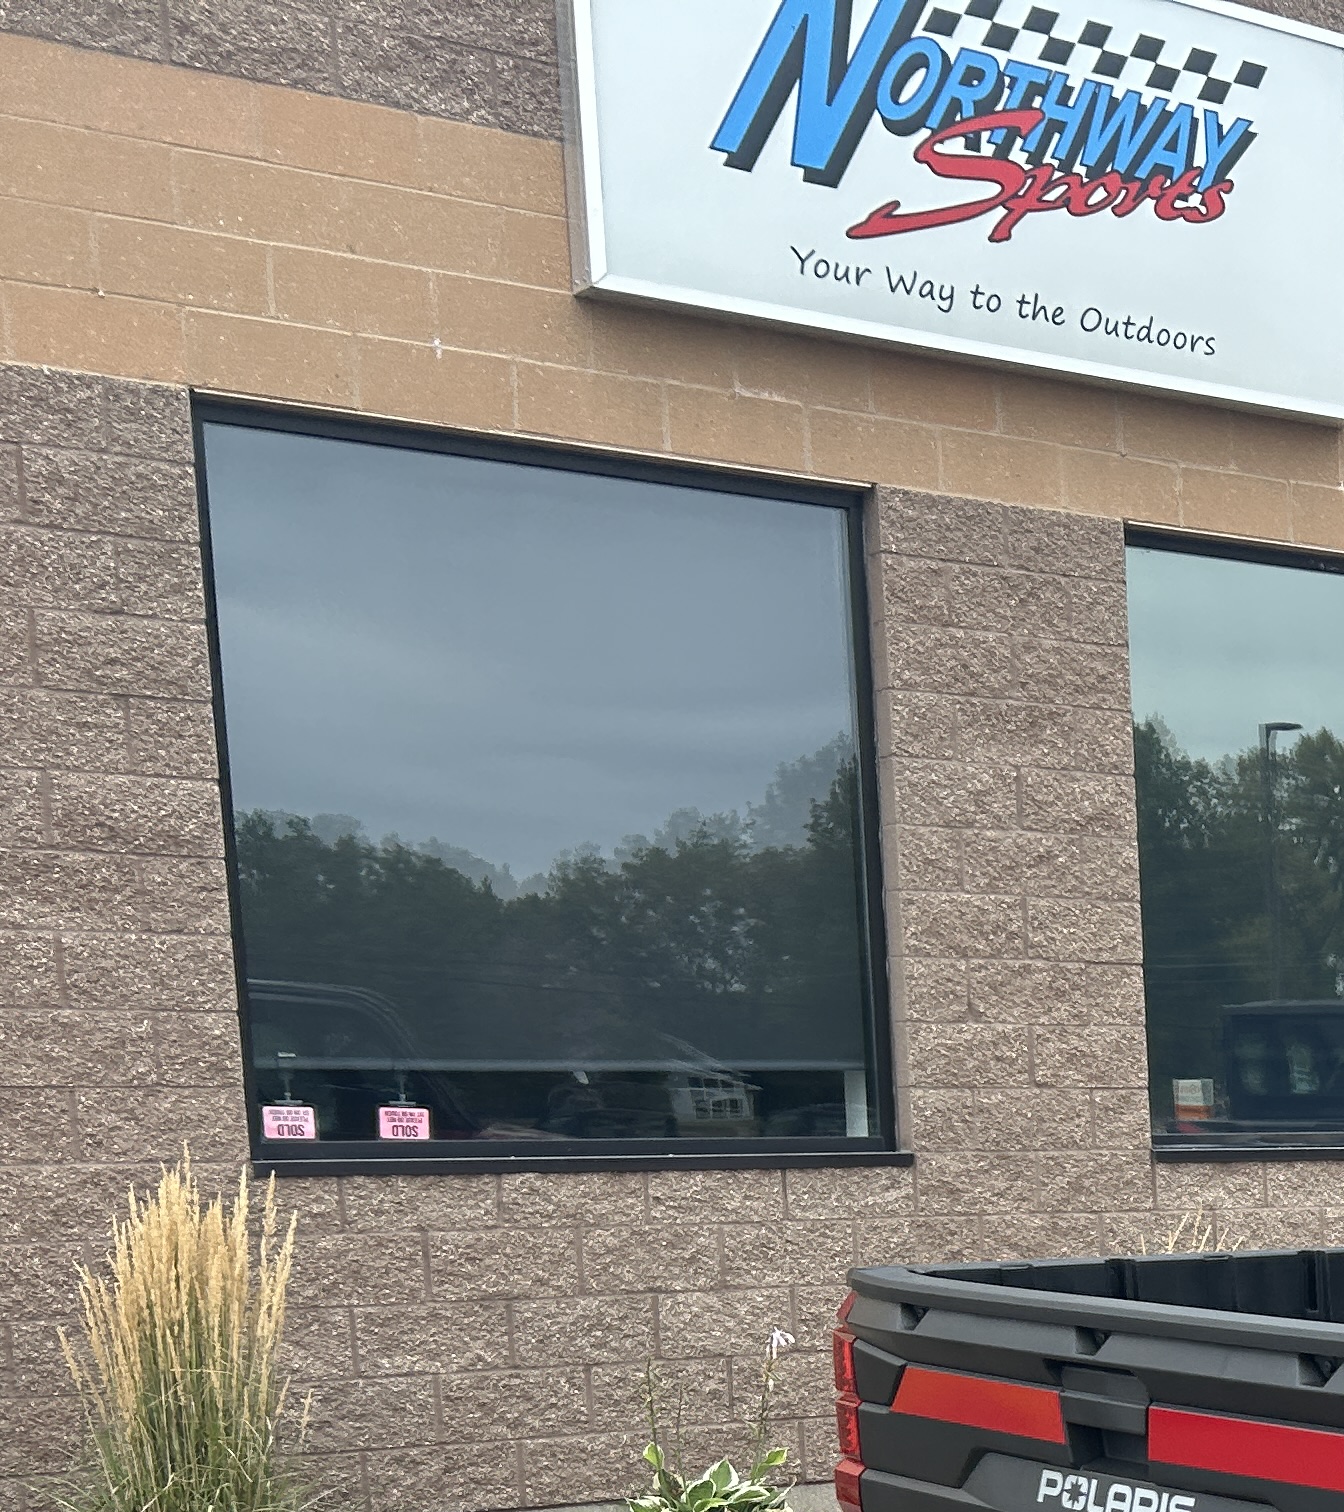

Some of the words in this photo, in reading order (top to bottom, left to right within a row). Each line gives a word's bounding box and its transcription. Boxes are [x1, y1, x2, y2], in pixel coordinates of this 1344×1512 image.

[708, 0, 1254, 192] NORTHWAY
[845, 108, 1234, 243] Sports
[790, 246, 872, 287] Your
[885, 265, 955, 313] Way
[970, 284, 1002, 314] to
[1016, 292, 1066, 327] the
[1080, 307, 1217, 358] Outdoors
[277, 1124, 305, 1137] SOLD
[392, 1125, 418, 1138] SOLD
